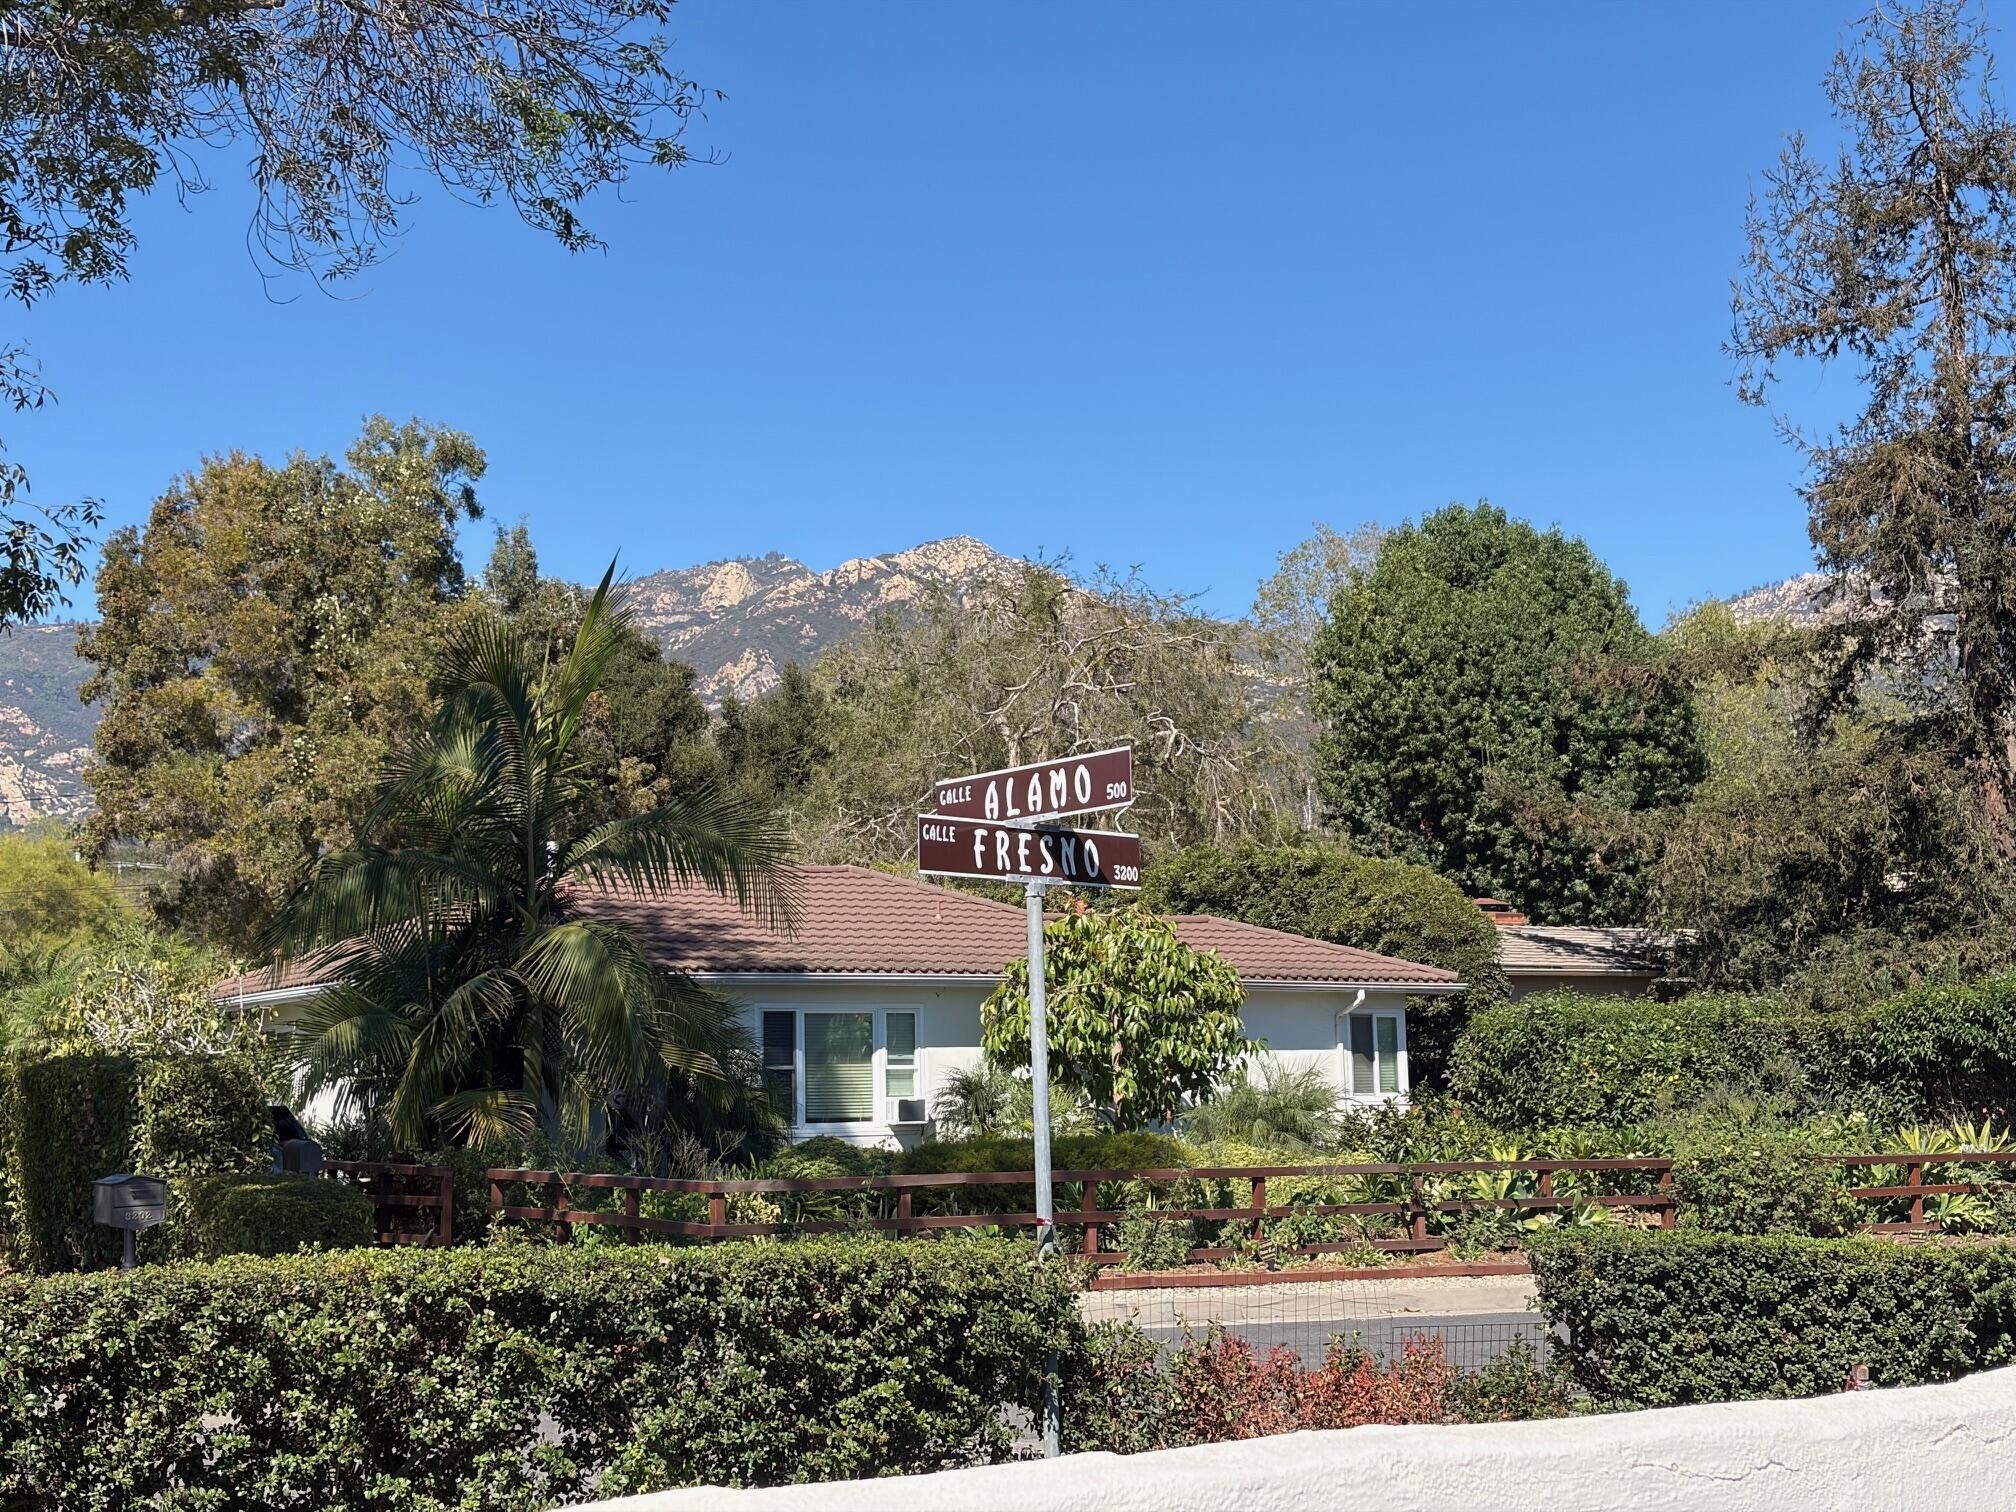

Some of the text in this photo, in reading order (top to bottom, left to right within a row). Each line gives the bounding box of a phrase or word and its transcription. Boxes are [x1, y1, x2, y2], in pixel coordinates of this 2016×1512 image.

[939, 764, 1127, 819] CALLE ALAMO 500
[922, 823, 1139, 882] CALLE FRESNO 3200
